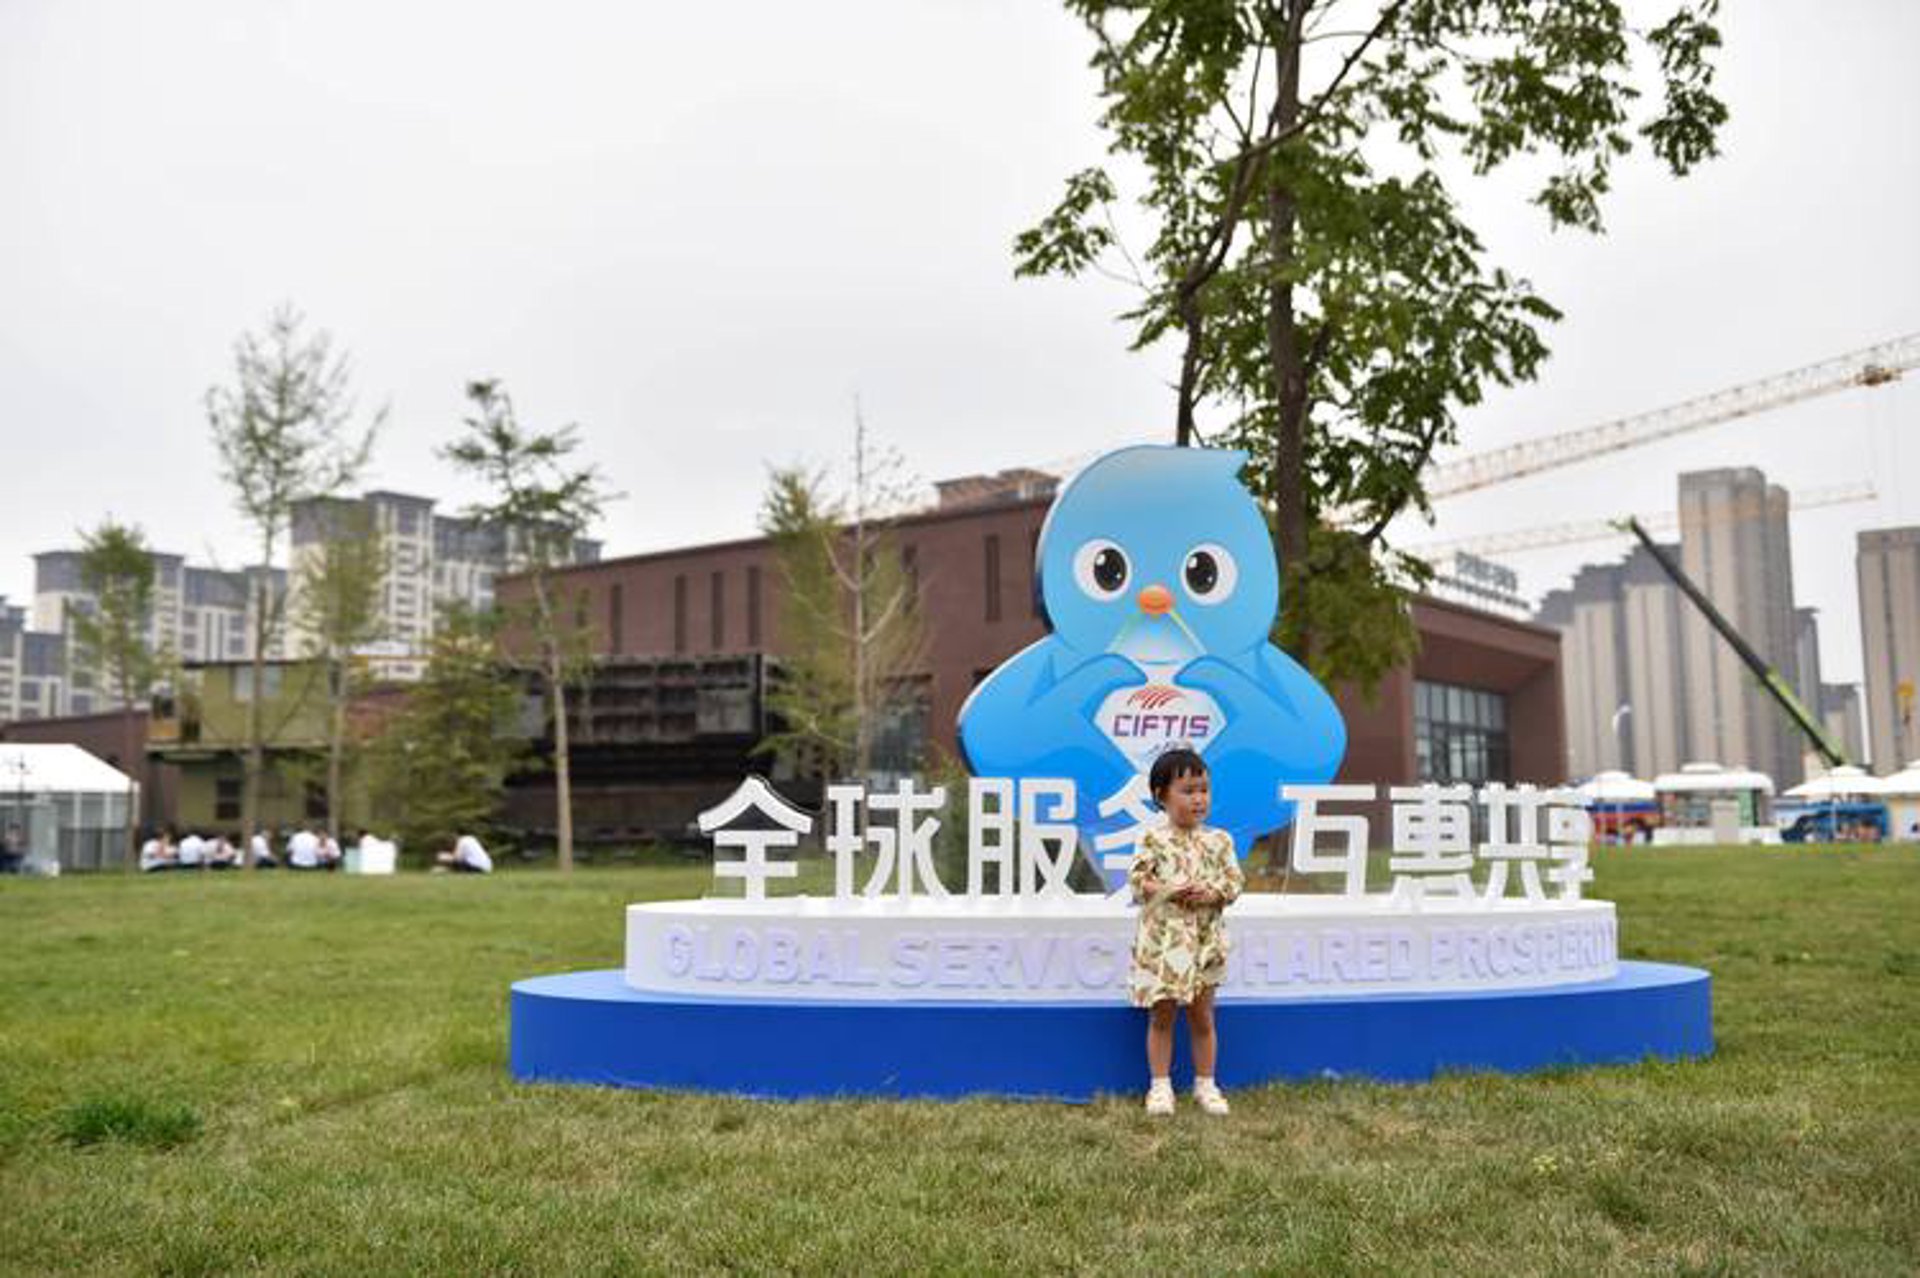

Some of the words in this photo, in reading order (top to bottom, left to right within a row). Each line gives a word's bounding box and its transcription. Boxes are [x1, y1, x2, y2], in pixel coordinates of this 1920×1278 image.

[1113, 714, 1210, 737] CIFTIS
[1281, 782, 1594, 900] 互惠共享
[662, 922, 880, 986] GLOBAL
[888, 930, 1130, 989] SERVIC
[1227, 926, 1412, 987] HARED
